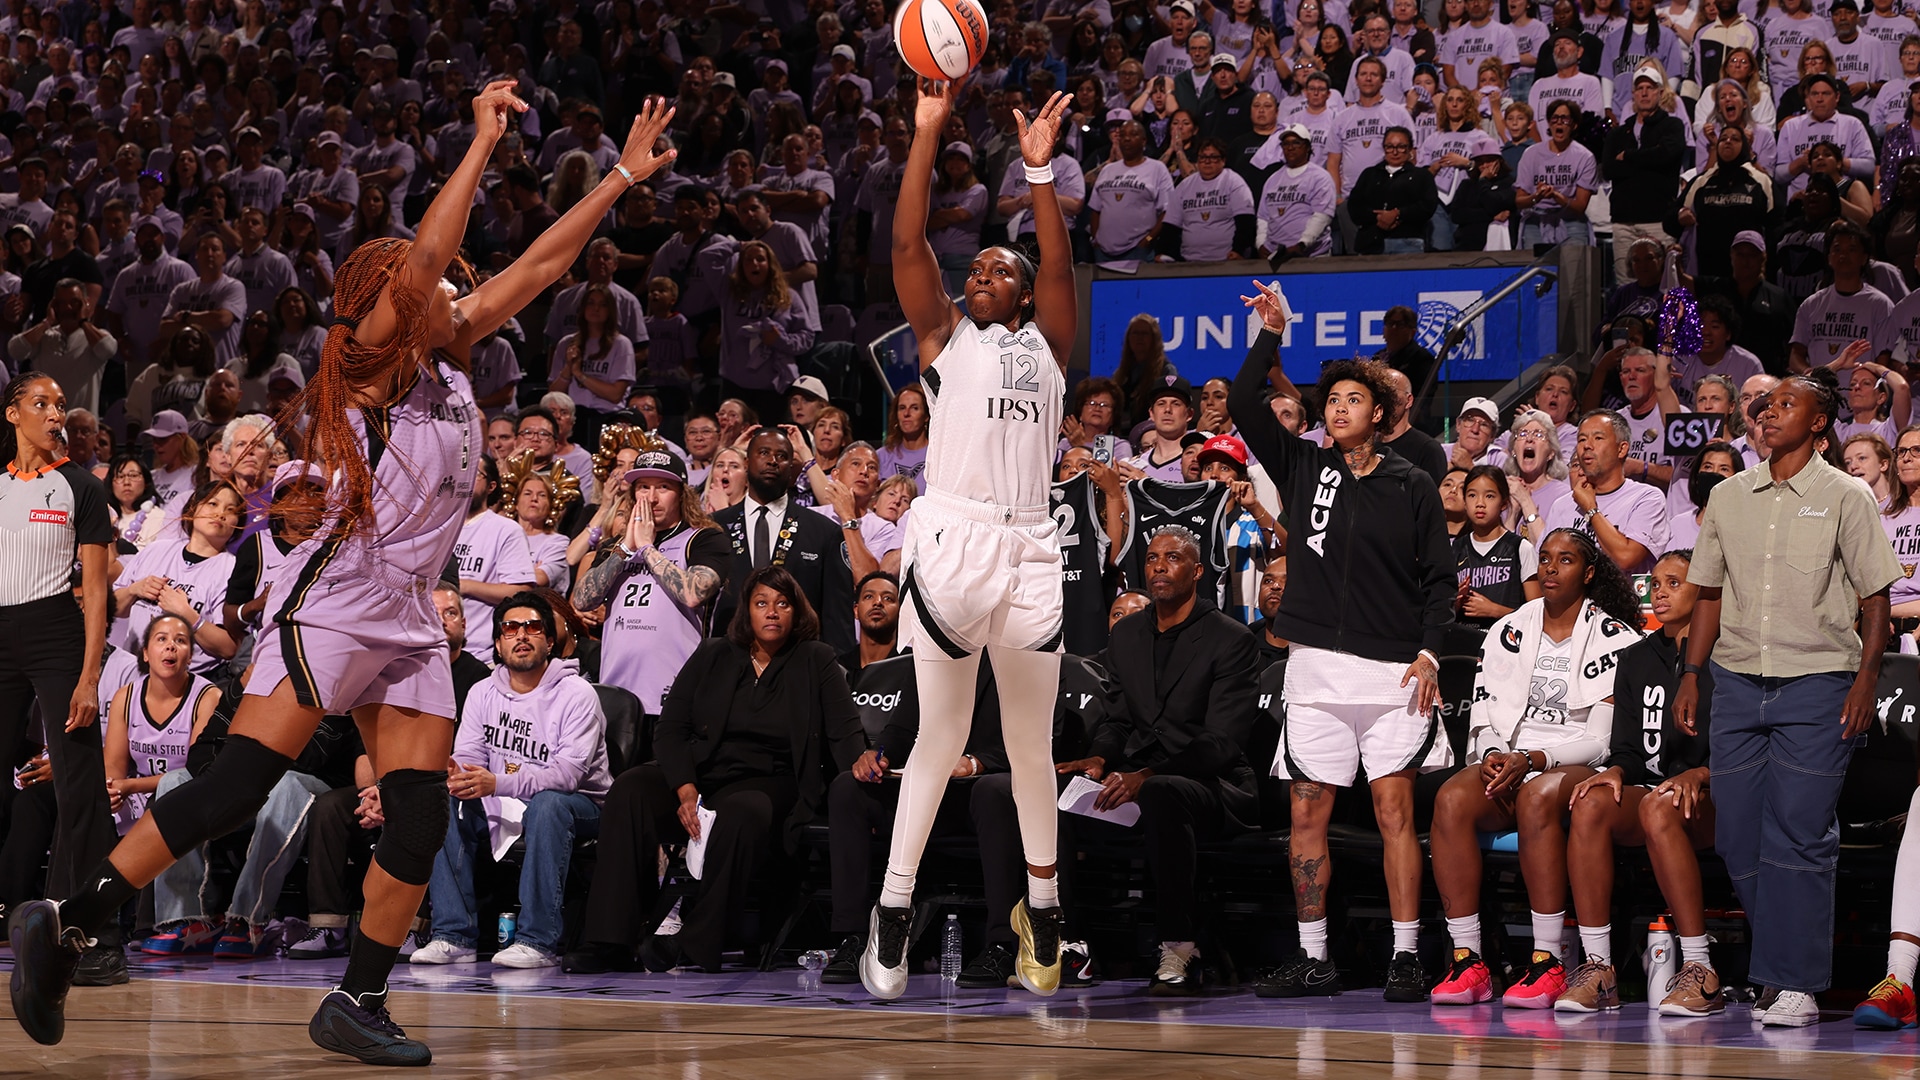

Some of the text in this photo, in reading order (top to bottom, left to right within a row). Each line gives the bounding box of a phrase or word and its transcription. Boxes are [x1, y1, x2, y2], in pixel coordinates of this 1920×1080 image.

[1545, 164, 1572, 174] WE ARE
[1825, 312, 1856, 323] WE ARE
[1000, 352, 1039, 393] 12
[987, 397, 1046, 423] IPSY
[1667, 417, 1722, 449] GSV
[30, 511, 67, 523] Emirates
[1191, 515, 1207, 526] ally
[1306, 466, 1342, 558] ACES
[1797, 506, 1829, 518] Elwood
[1051, 503, 1081, 546] 2
[1896, 524, 1912, 538] WE
[1062, 569, 1083, 583] T&T
[1457, 565, 1511, 589] VALKYRIES
[624, 583, 652, 607] 22
[1533, 655, 1571, 673] CE
[1530, 675, 1568, 711] 32
[513, 718, 533, 737] ARE
[1642, 684, 1665, 777] ACES
[131, 740, 186, 756] GOLDEN STATE
[148, 758, 168, 776] 13
